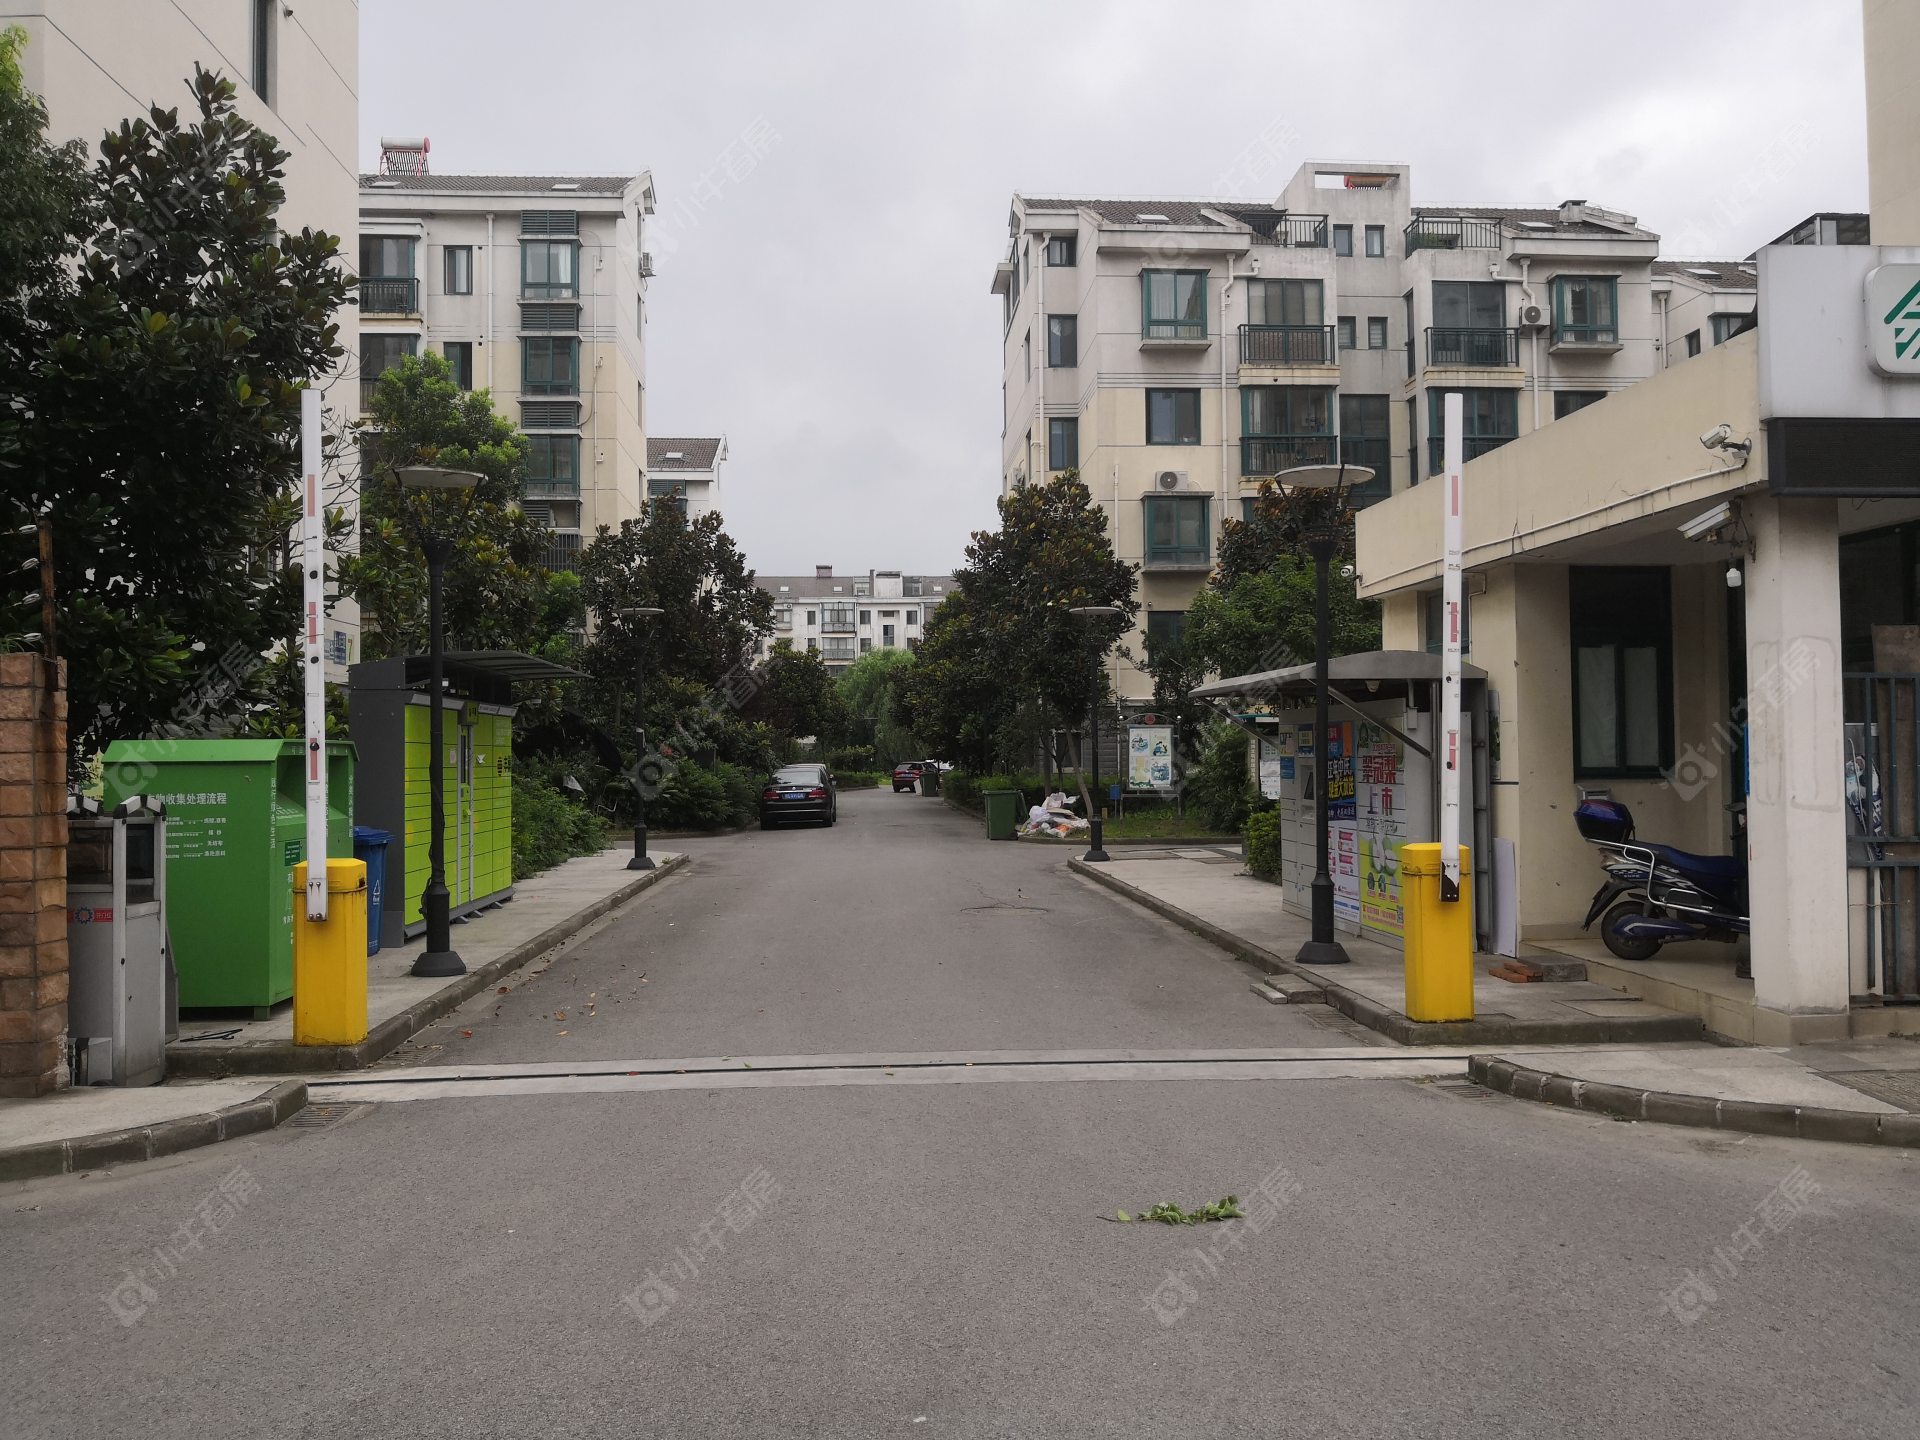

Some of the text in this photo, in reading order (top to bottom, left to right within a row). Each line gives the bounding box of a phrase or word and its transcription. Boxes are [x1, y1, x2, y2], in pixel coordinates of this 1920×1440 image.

[148, 792, 227, 805] 物收集处理流程
[1367, 786, 1393, 816] 上市
